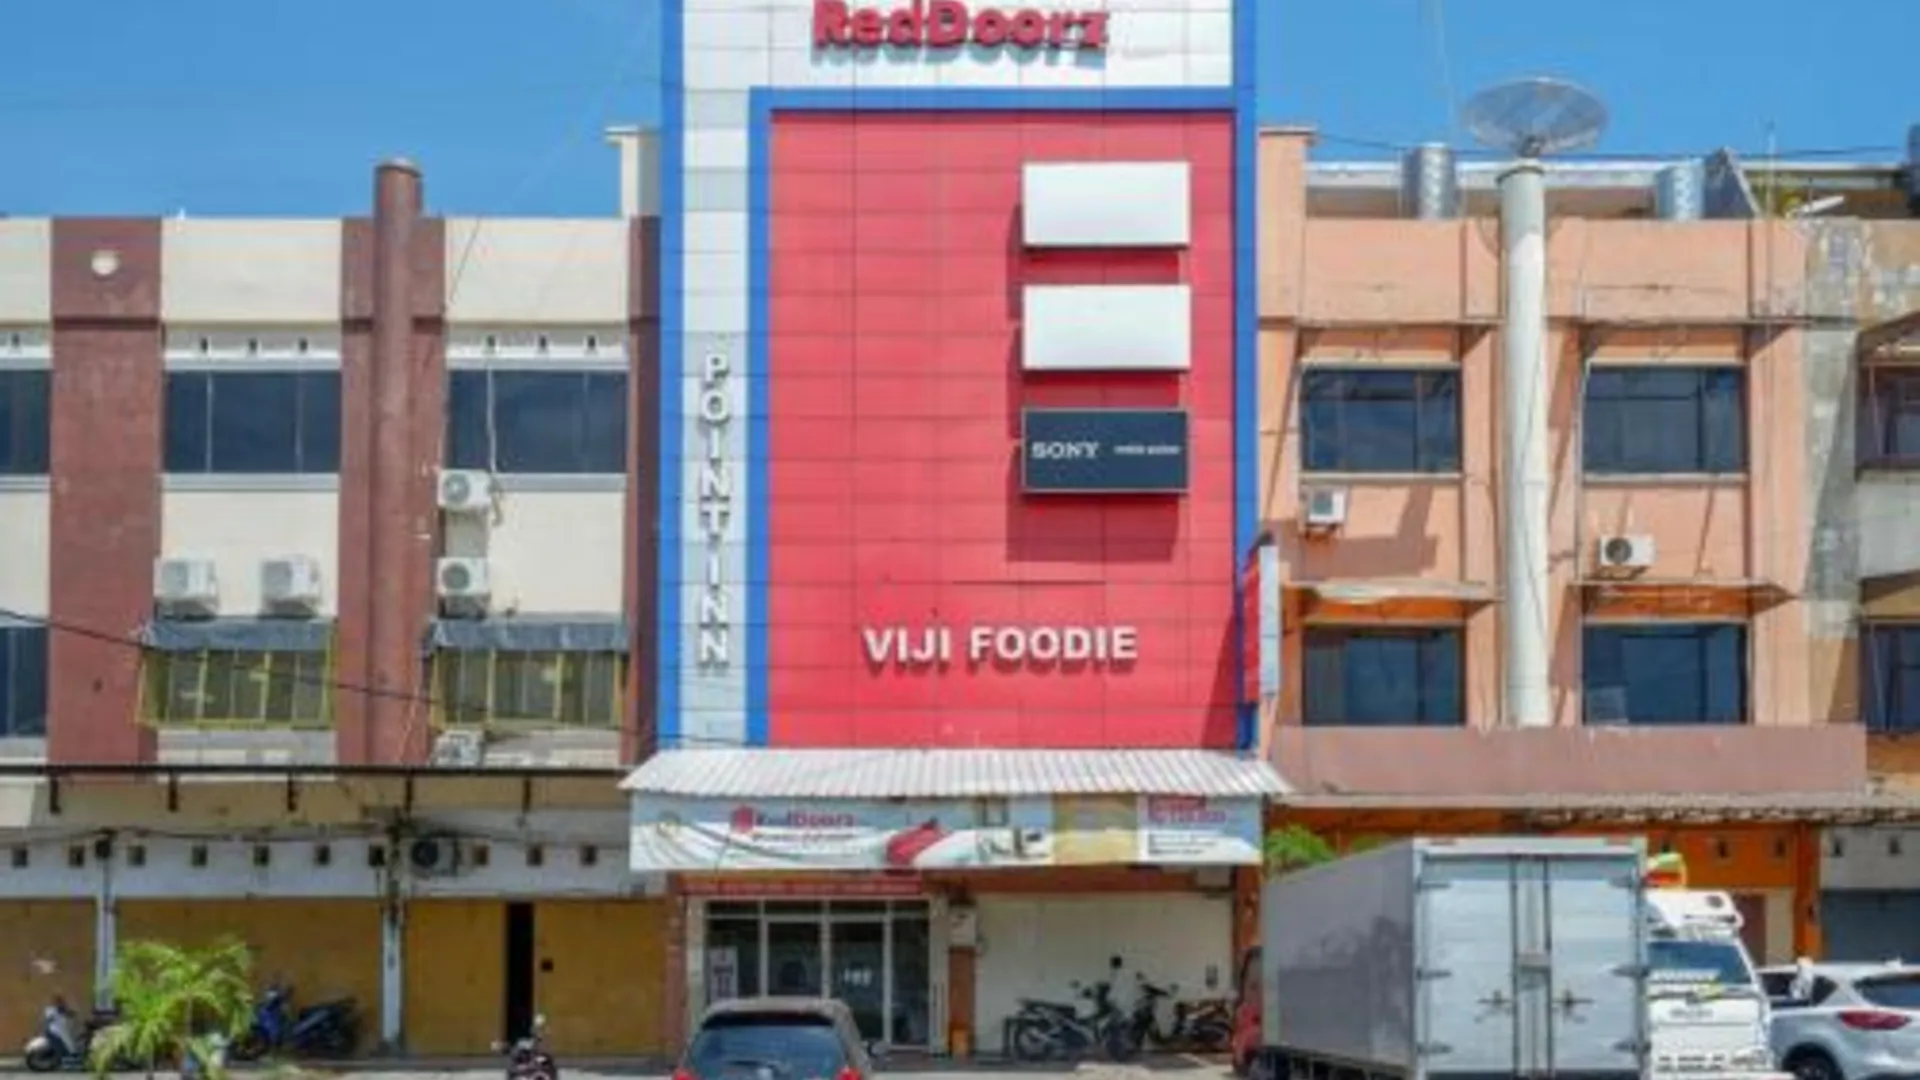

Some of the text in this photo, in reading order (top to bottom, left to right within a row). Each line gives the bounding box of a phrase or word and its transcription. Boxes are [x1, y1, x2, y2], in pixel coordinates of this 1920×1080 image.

[812, 0, 1109, 47] RedDoorz
[1031, 441, 1100, 459] SONY
[863, 626, 1138, 662] VIJI FOODIE
